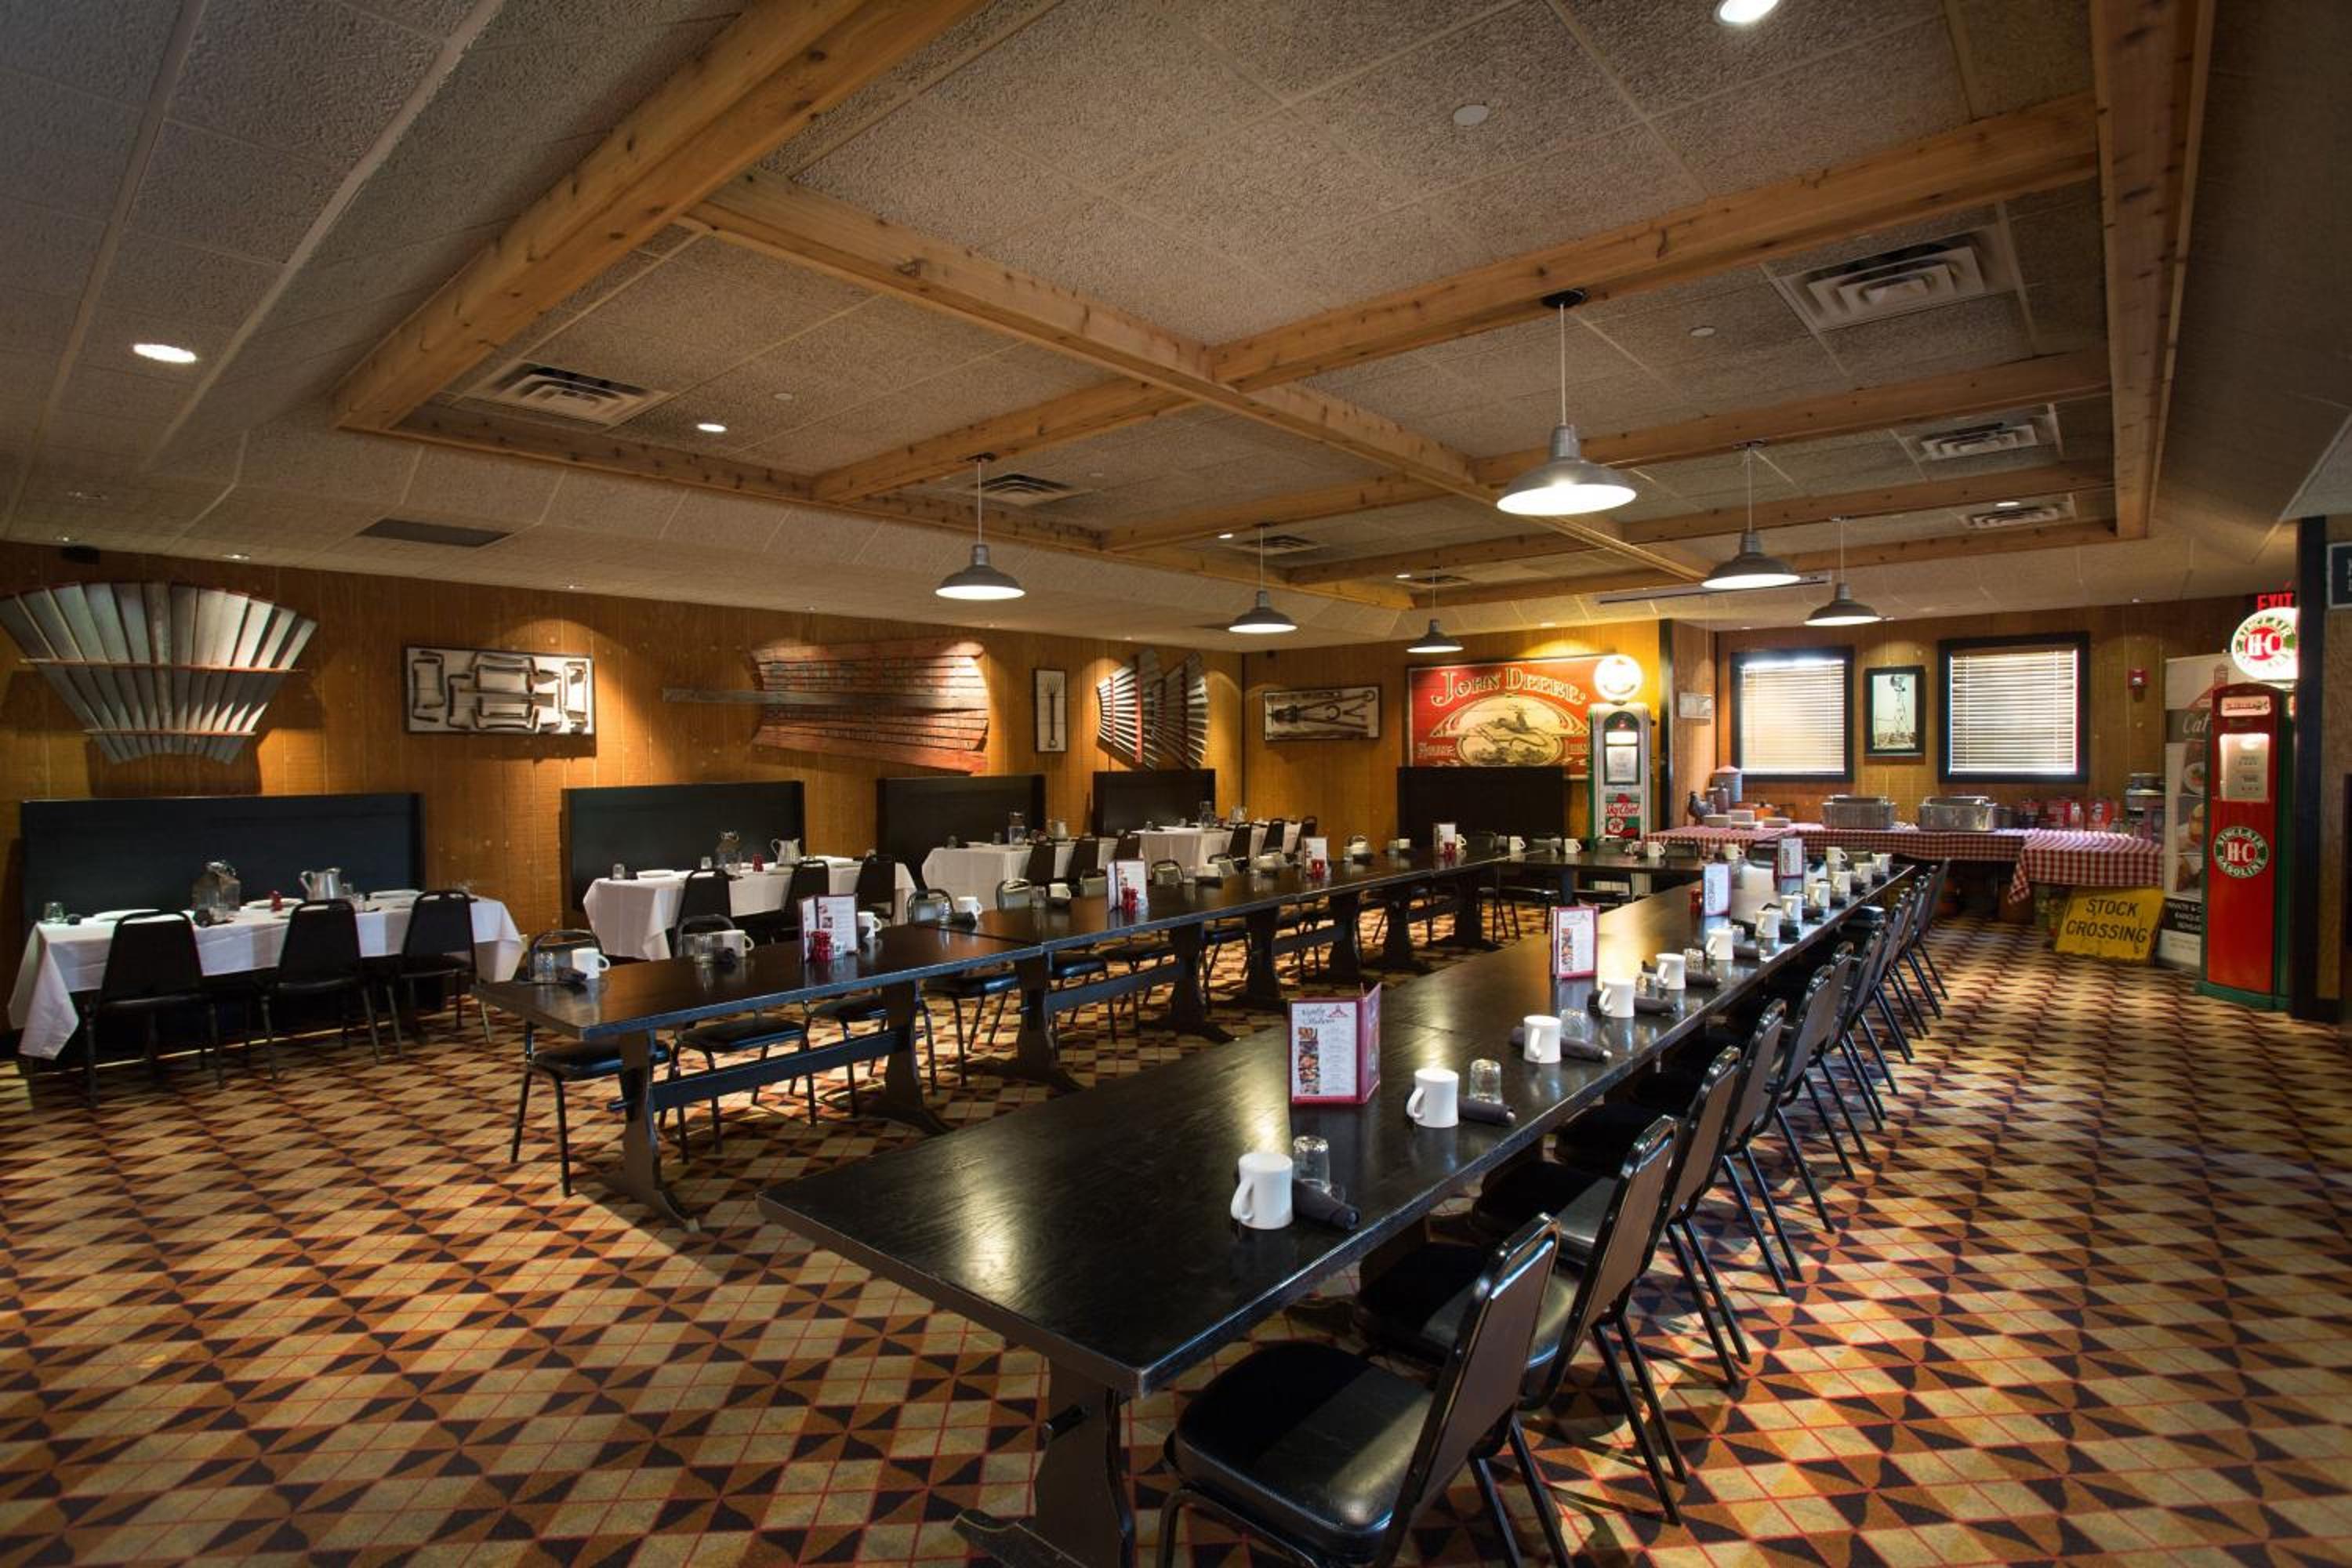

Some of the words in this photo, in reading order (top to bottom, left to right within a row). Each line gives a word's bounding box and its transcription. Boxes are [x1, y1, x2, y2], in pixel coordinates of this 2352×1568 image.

[2257, 593, 2292, 611] EXIT
[1430, 670, 1501, 707] JOHN
[2217, 855, 2265, 877] GASOLINE
[2086, 898, 2138, 916] STOCK
[2066, 920, 2147, 942] CROSSING
